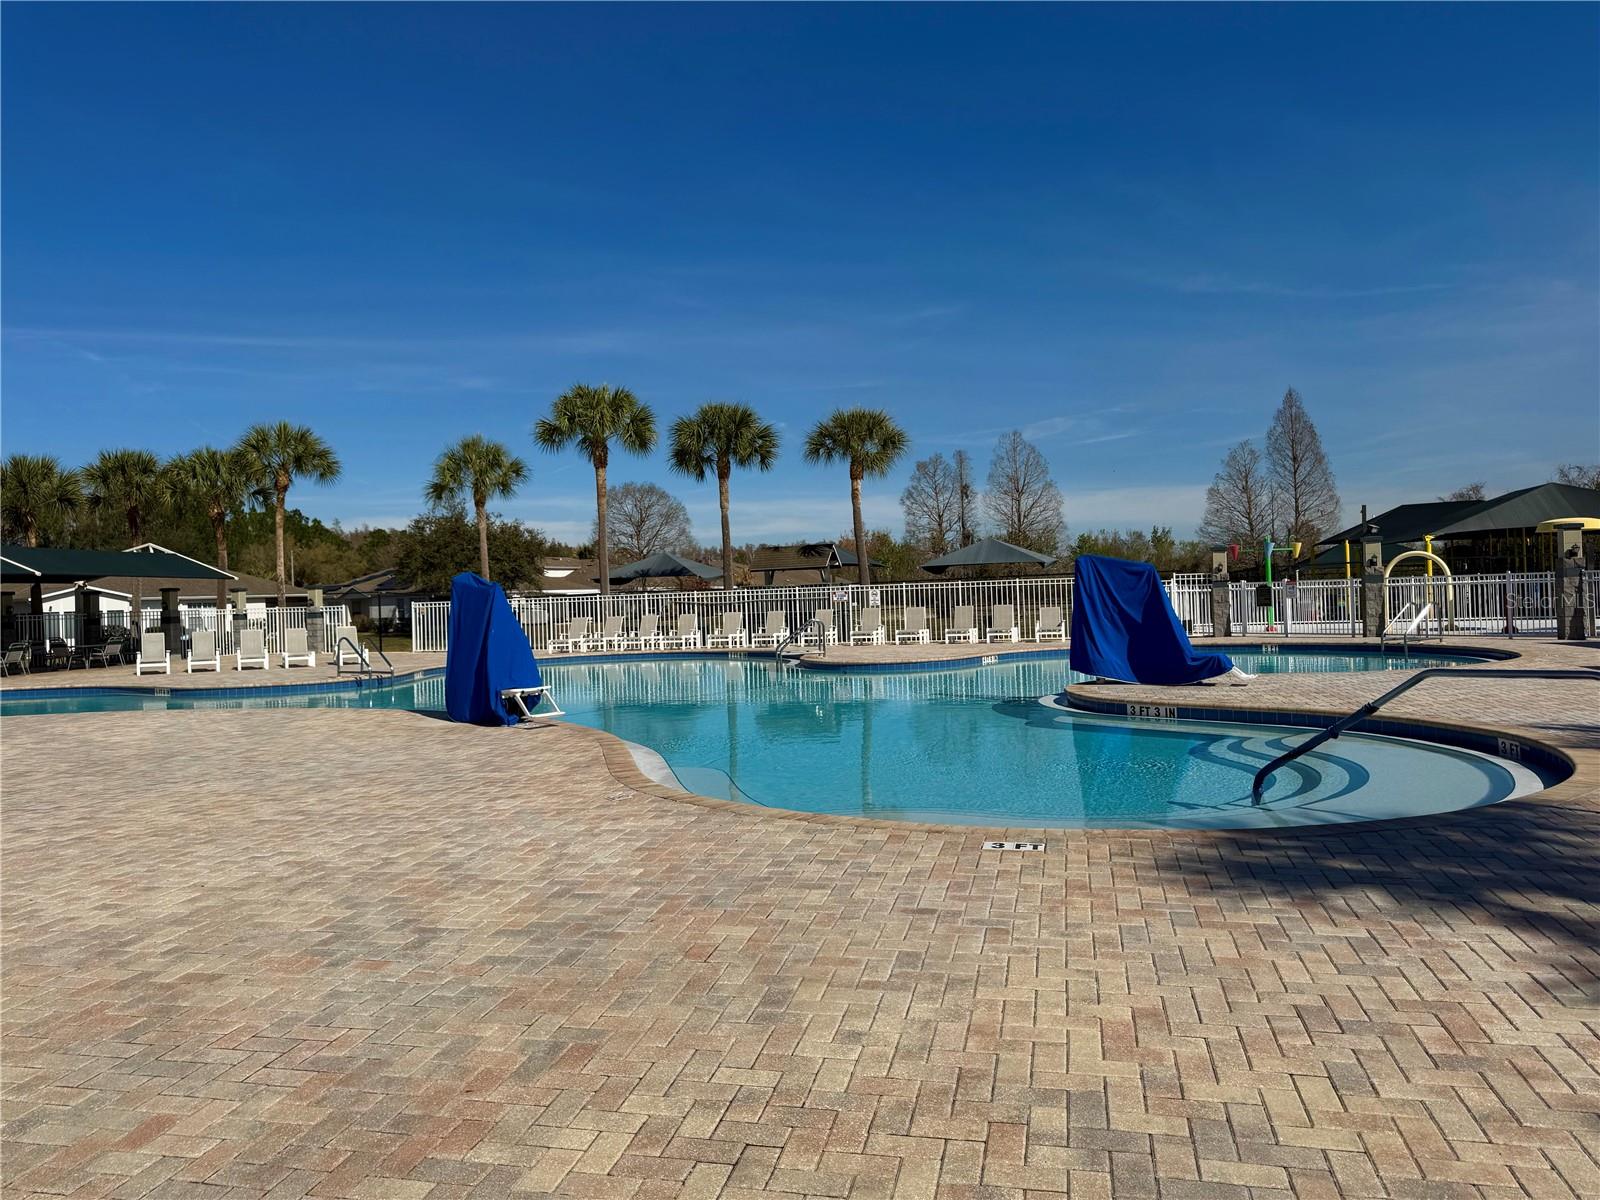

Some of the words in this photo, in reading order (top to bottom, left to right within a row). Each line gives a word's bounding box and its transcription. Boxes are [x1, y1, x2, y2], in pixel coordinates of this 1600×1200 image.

[1130, 705, 1136, 716] 3
[1139, 706, 1151, 717] FT
[1154, 706, 1161, 718] 3
[1165, 707, 1176, 719] IN
[1501, 741, 1507, 754] 3
[1510, 743, 1519, 757] FT
[991, 842, 1005, 850] 3
